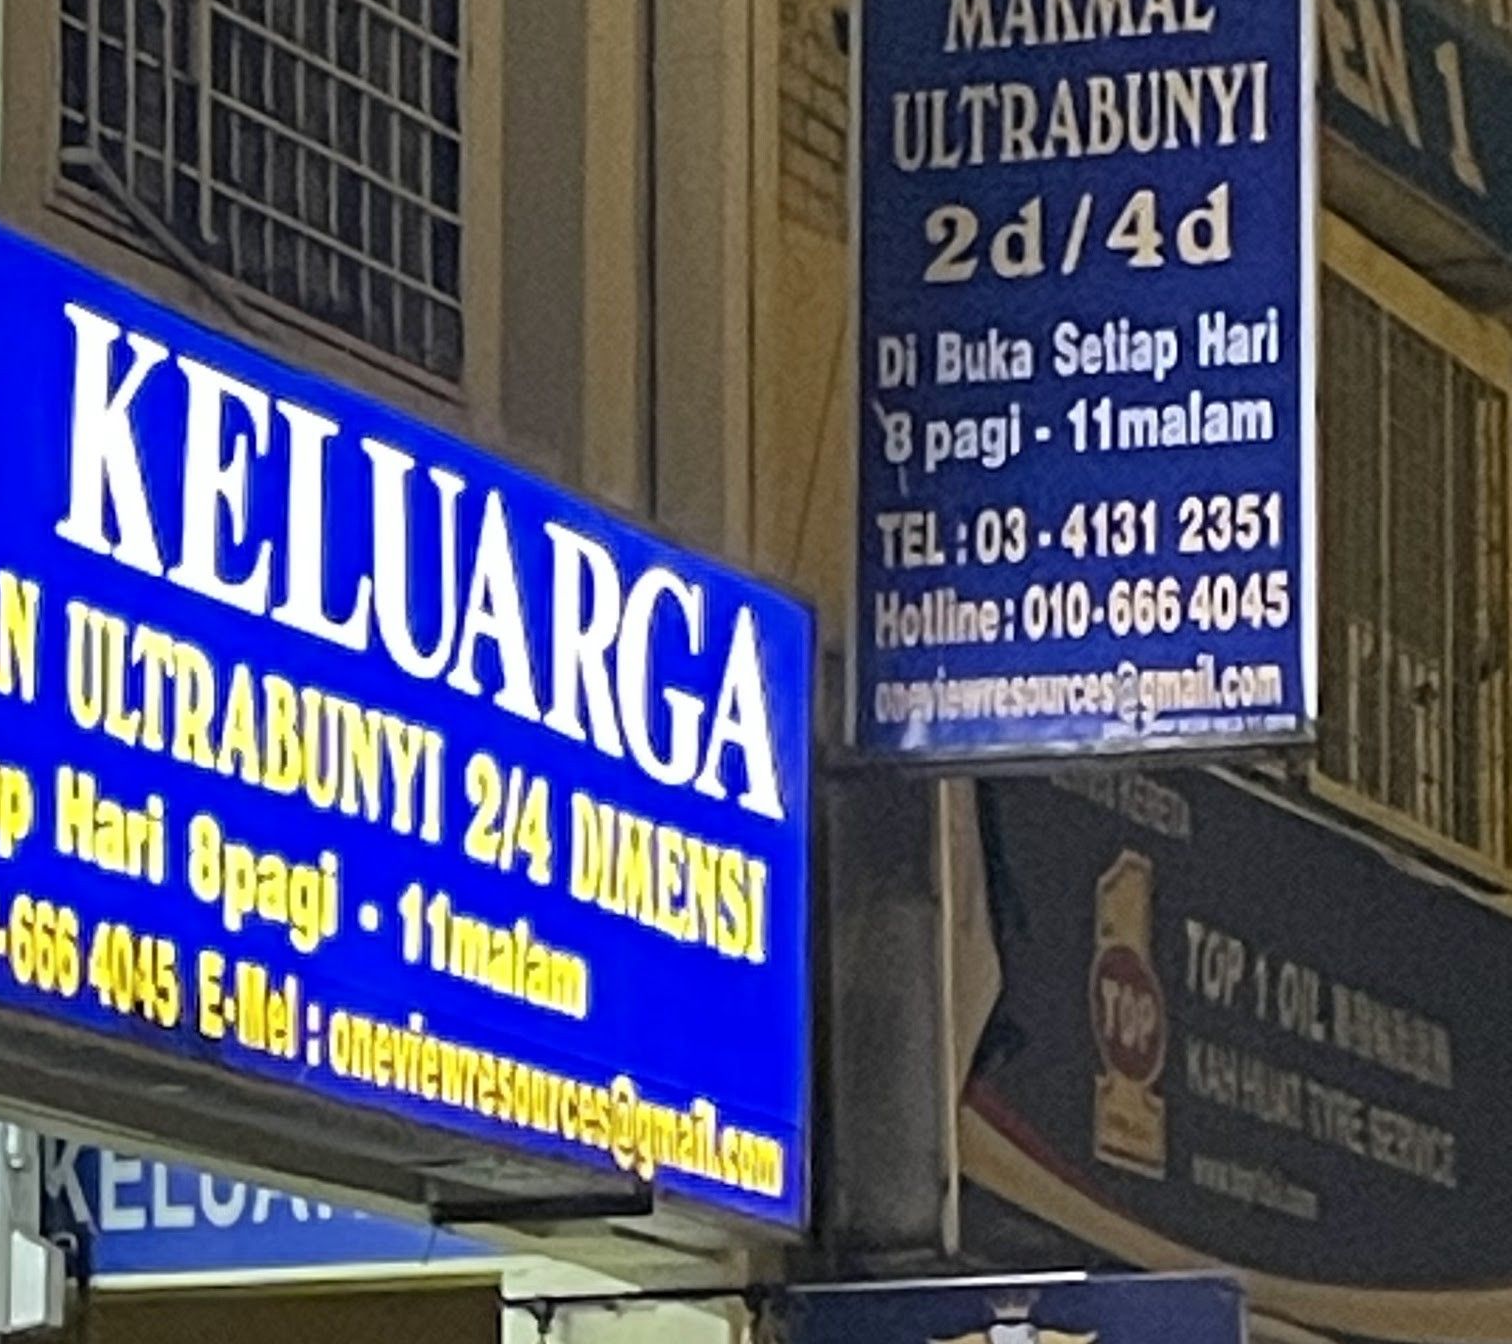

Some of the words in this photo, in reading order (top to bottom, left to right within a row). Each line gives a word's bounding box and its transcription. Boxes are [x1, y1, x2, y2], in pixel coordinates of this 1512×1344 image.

[893, 62, 1268, 173] ULTRABUNYI
[877, 333, 916, 388] Di
[936, 328, 1034, 384] Buka
[1052, 317, 1178, 382] Setiap
[1197, 307, 1279, 368] Hari
[925, 402, 1021, 472] pagi
[1066, 390, 1274, 452] 11malam
[55, 301, 785, 821] KELUARGA
[1178, 491, 1282, 553] 2351
[1022, 575, 1181, 641] 010-666
[1188, 570, 1288, 631] 4045
[66, 599, 444, 842] ULTRABUNYI
[462, 753, 552, 885] 2/4
[569, 791, 767, 964] DIMENSI
[56, 766, 166, 884] Hari
[189, 815, 338, 952] 8pagi
[398, 882, 590, 1020] 11malam
[89, 922, 181, 1028] 4045
[328, 1014, 783, 1197] oneviewresources@gmail.com
